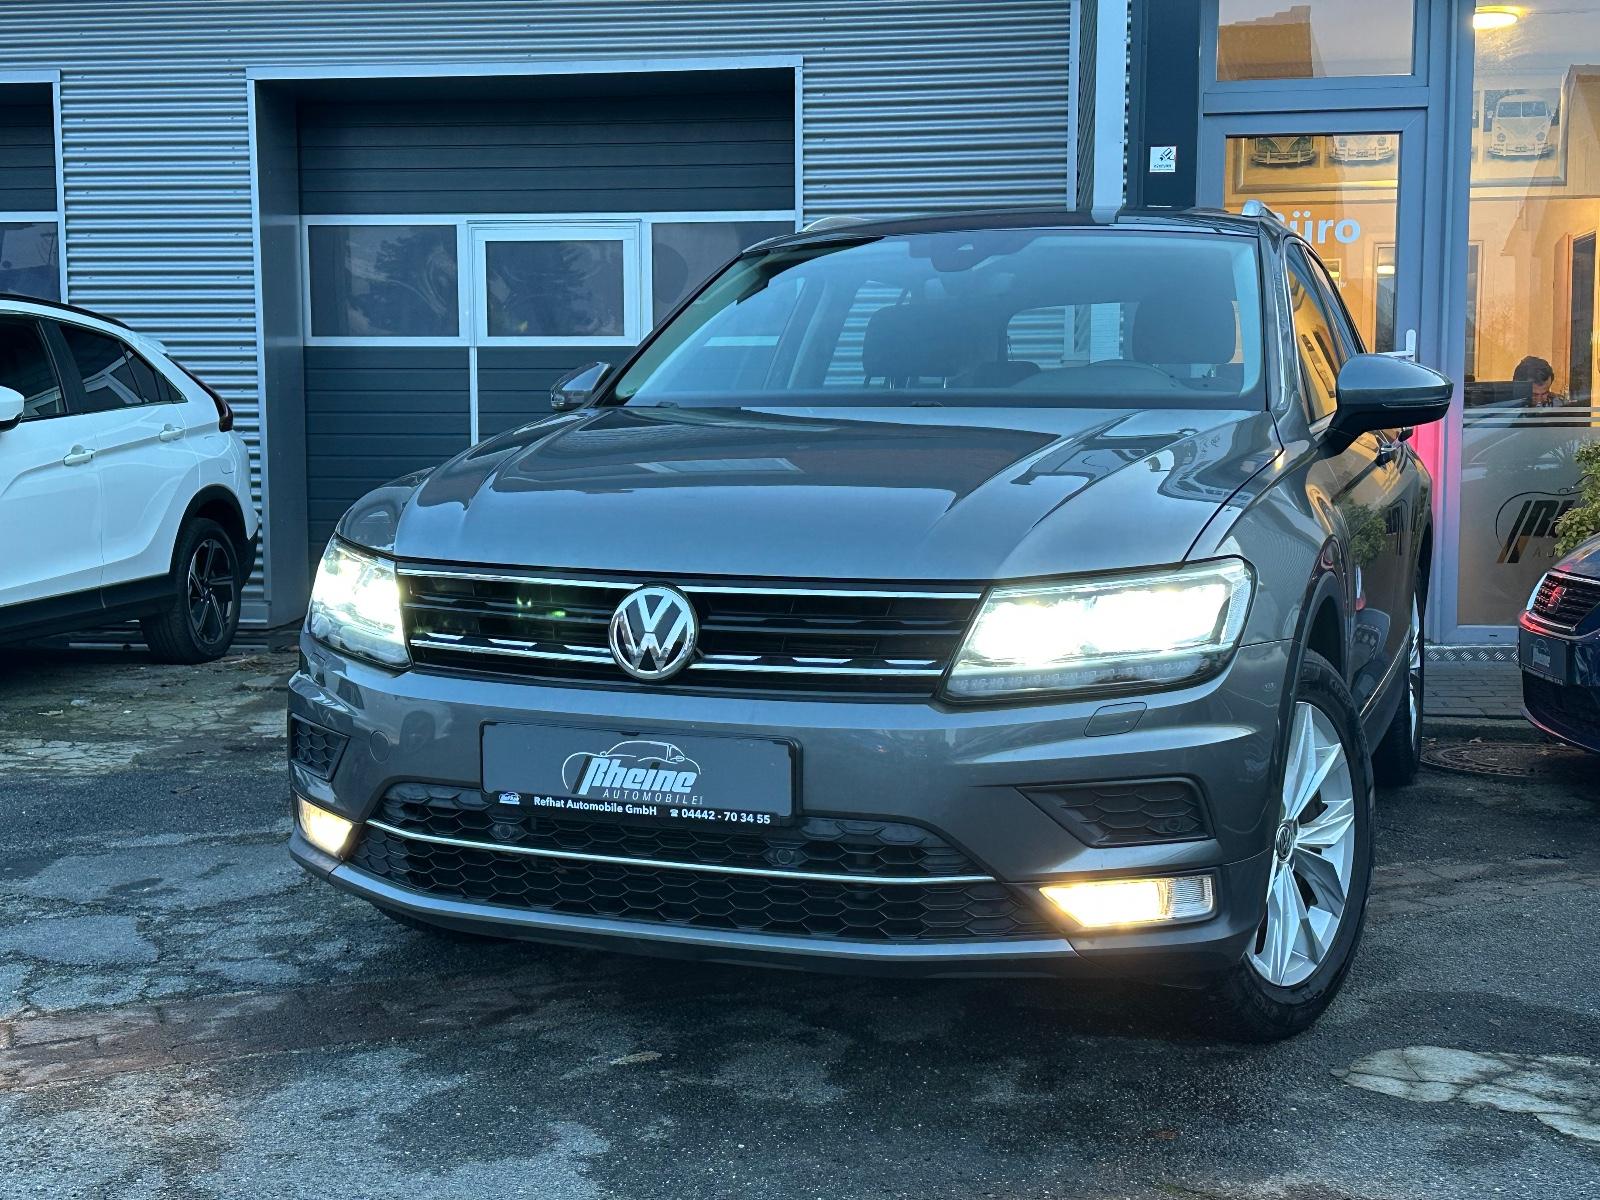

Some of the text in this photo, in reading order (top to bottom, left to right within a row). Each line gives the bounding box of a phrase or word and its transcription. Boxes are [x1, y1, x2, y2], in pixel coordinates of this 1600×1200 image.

[574, 757, 698, 796] Rheine
[533, 796, 565, 809] Refhat
[566, 799, 624, 813] Automobile
[625, 804, 658, 816] GmbH
[681, 808, 716, 820] 04442
[723, 811, 738, 822] 70
[740, 813, 755, 823] 34
[756, 814, 771, 825] 55
